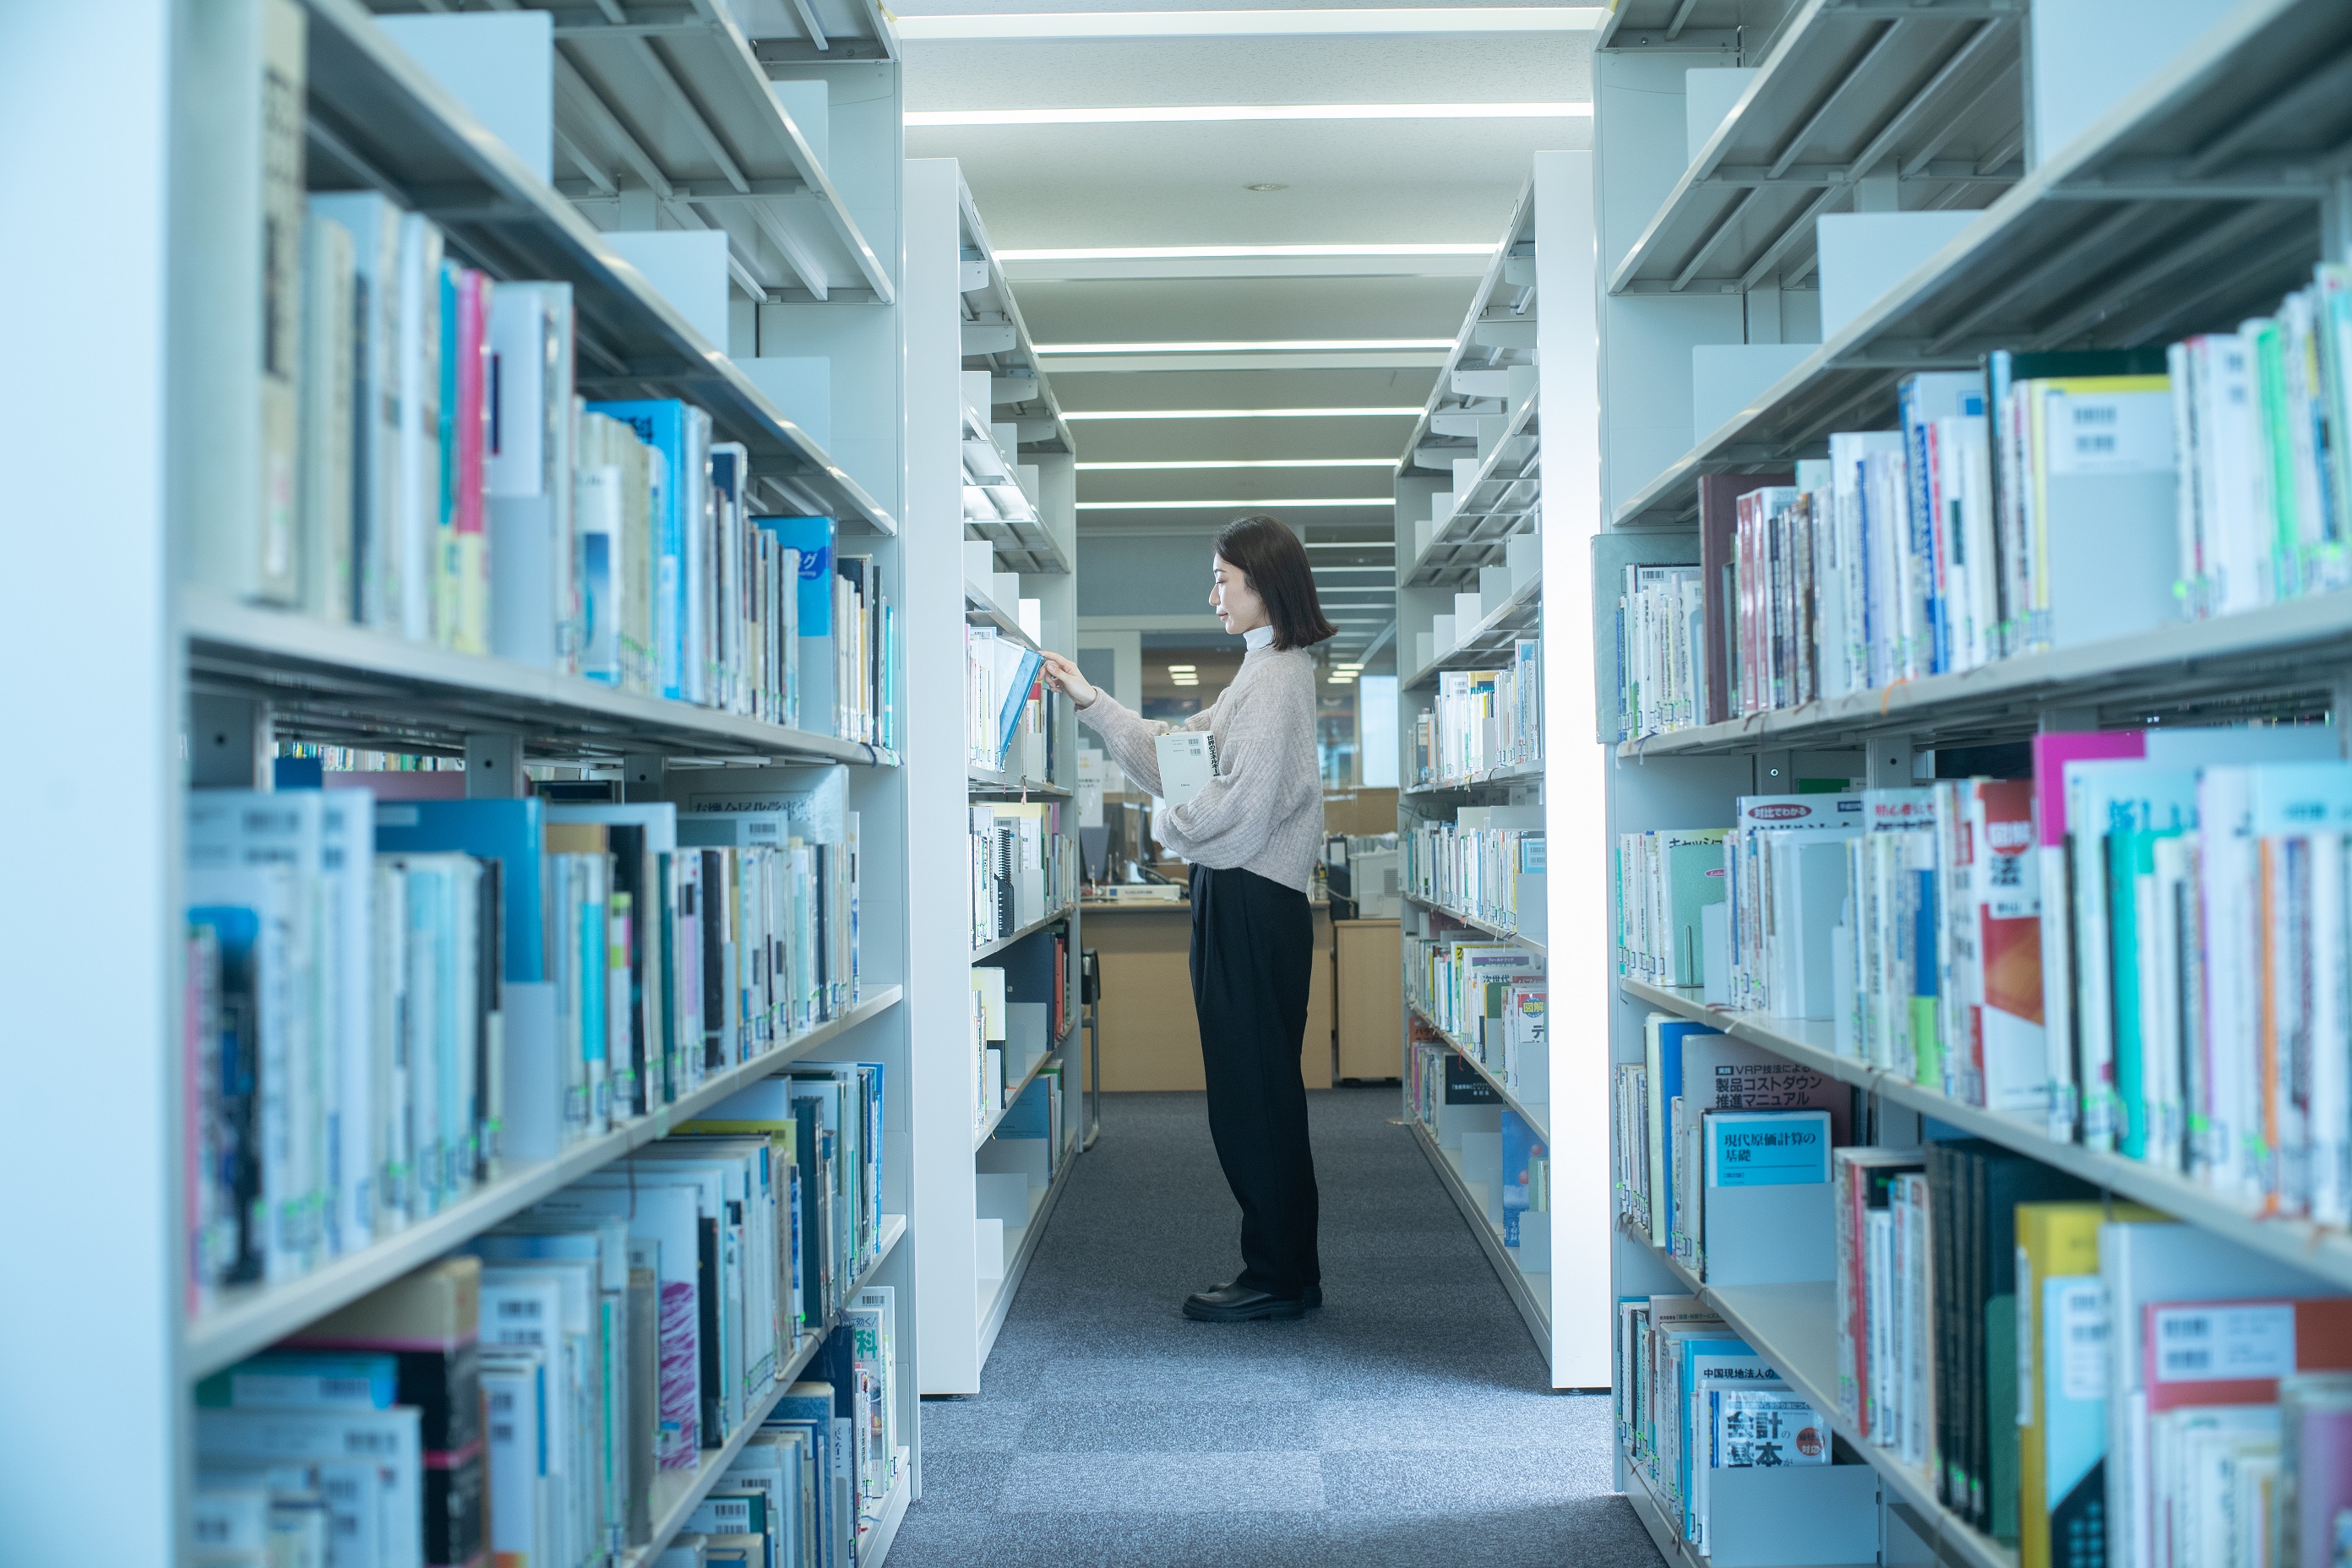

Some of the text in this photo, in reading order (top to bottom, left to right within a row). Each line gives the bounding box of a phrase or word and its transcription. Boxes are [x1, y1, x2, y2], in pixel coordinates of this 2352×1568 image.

[799, 553, 818, 570] グ
[1484, 974, 1511, 983] 次世代
[1523, 1002, 1544, 1013] 図解
[1736, 1064, 1810, 1075] VRP技法による
[1716, 1076, 1822, 1092] 製品コストダウン
[1716, 1092, 1810, 1108] 推進マニュアル
[1724, 1132, 1816, 1147] 現代原価計算の
[1726, 1149, 1751, 1162] 基礎
[856, 1329, 878, 1359] 科
[1704, 1368, 1775, 1379] 中国現地法人の
